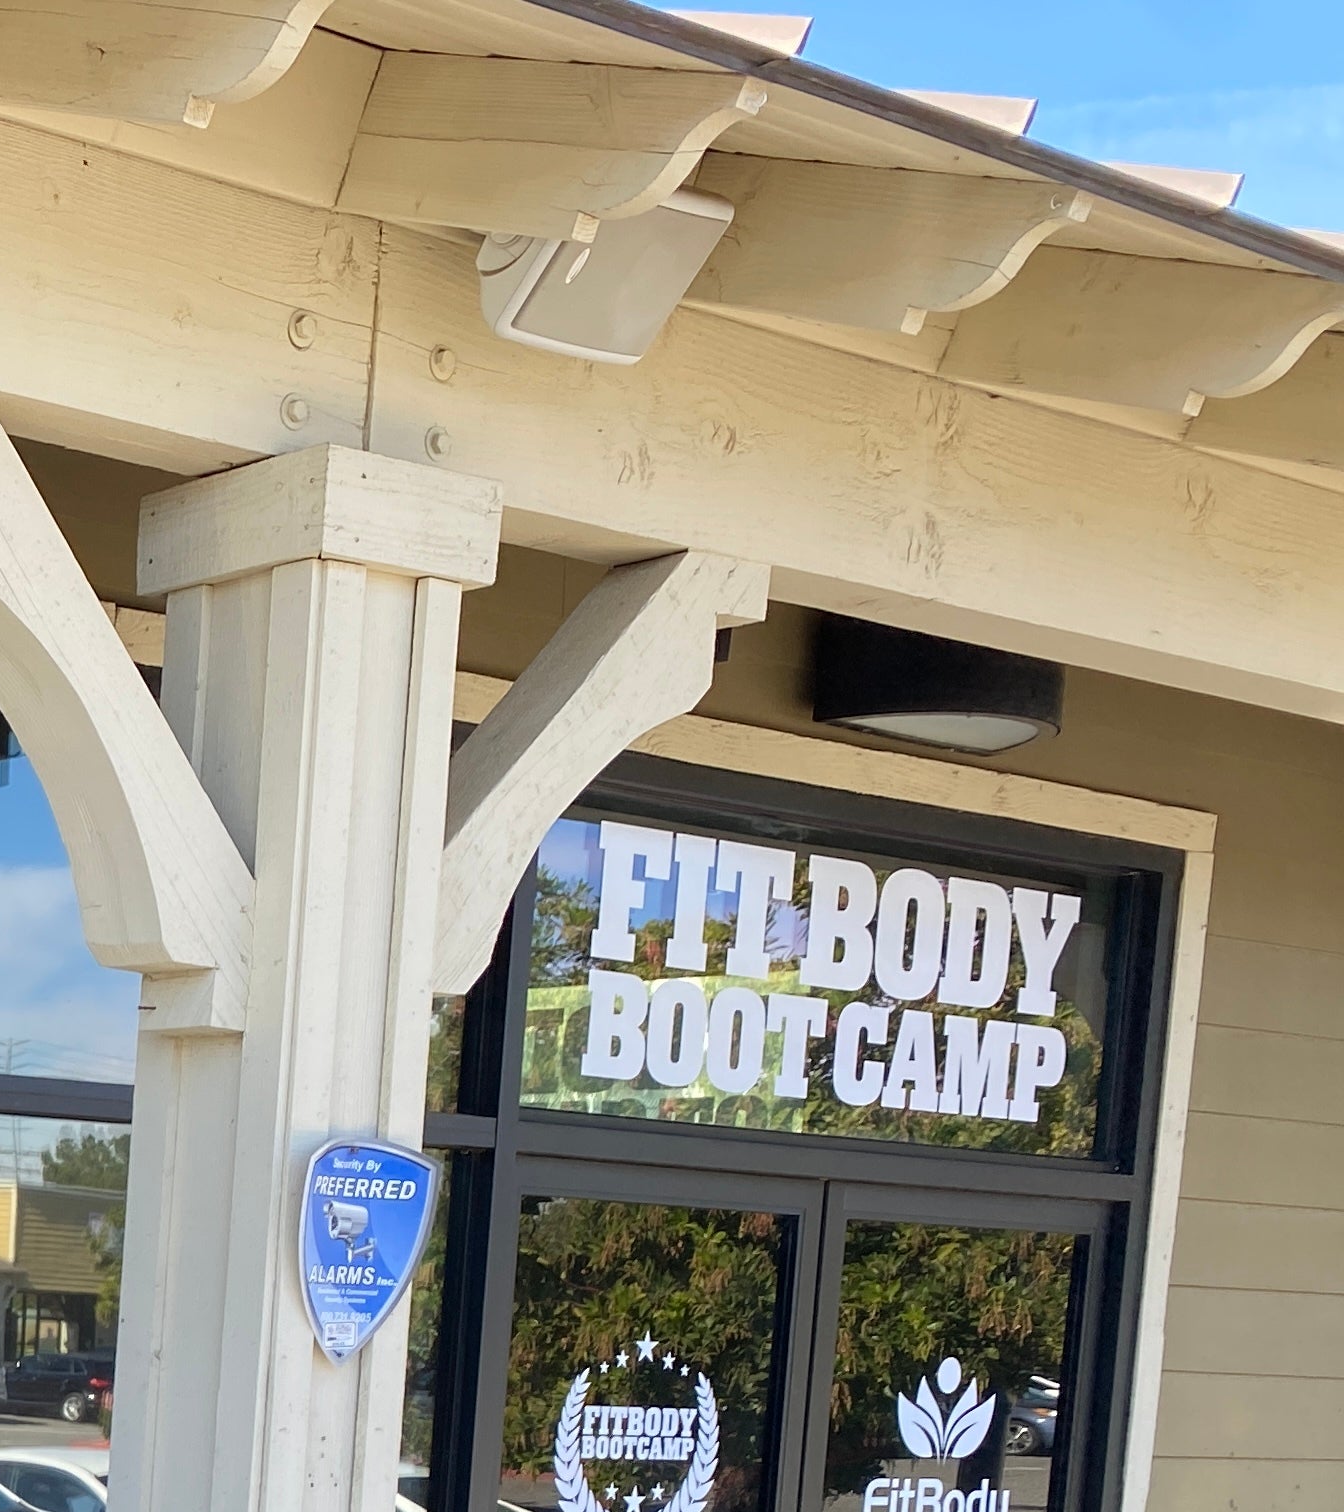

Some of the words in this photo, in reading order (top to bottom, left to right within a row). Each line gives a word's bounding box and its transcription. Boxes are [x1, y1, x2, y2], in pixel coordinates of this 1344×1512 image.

[590, 819, 796, 980] FIT
[799, 853, 1082, 1017] BODY
[580, 968, 829, 1100] BOOT
[832, 1000, 1067, 1124] CAMP
[333, 1157, 364, 1173] Security
[365, 1159, 382, 1174] By
[313, 1175, 417, 1200] PREFERRED
[309, 1265, 376, 1286] ALARMS
